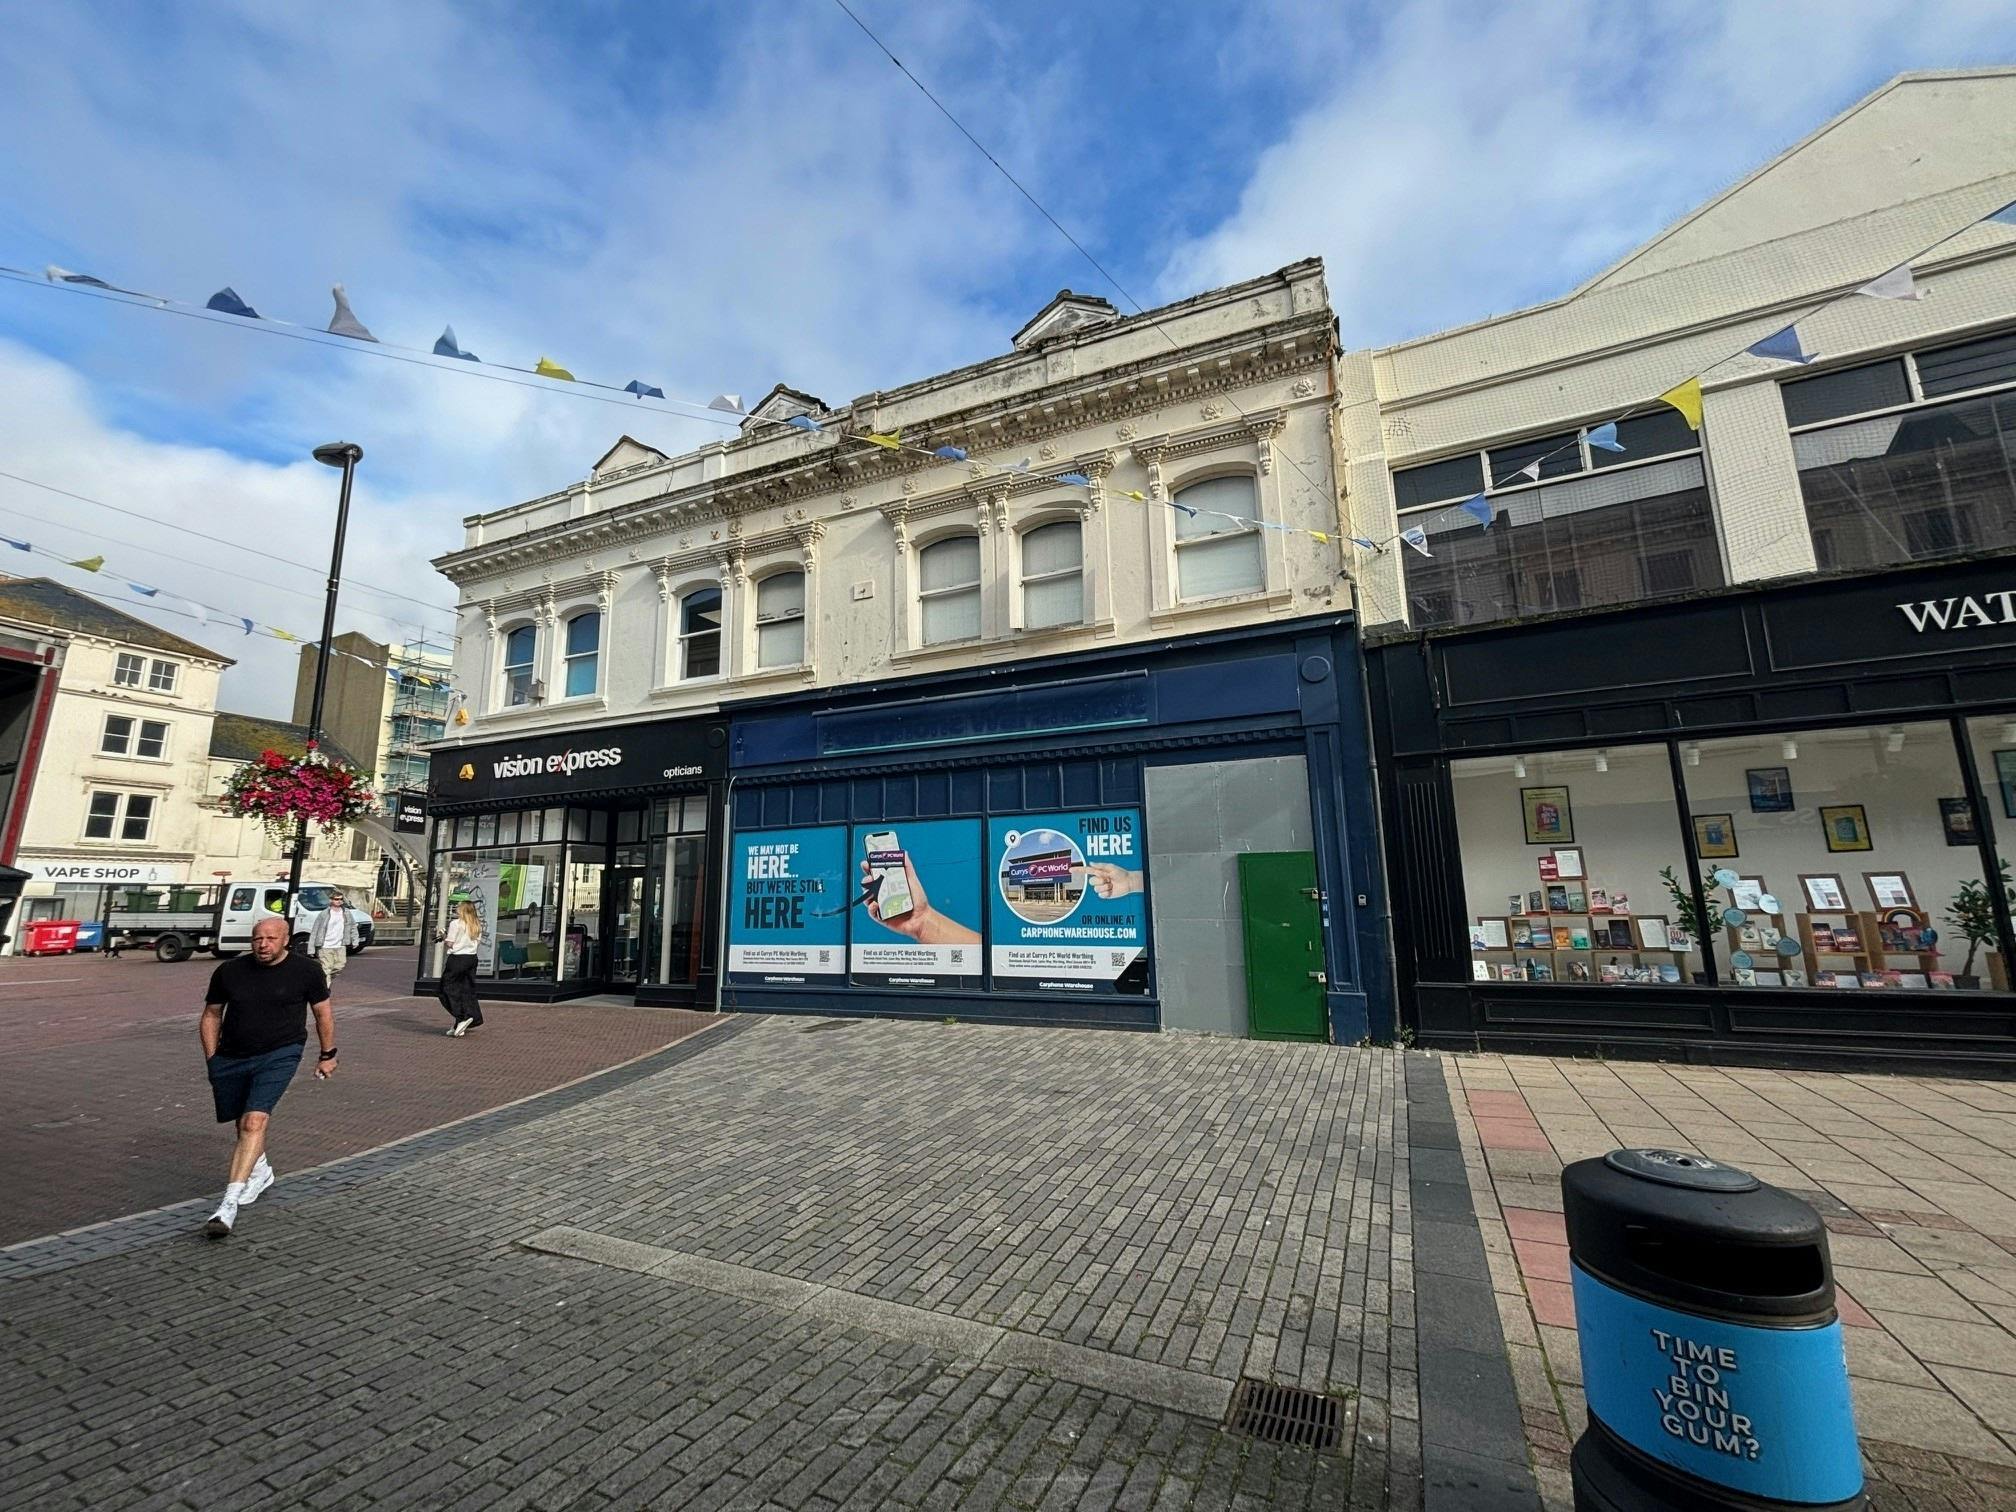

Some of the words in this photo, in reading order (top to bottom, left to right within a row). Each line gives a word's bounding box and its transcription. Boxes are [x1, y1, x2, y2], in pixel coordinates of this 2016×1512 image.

[494, 754, 542, 778] vision
[546, 748, 621, 776] express
[663, 765, 702, 779] opticians
[404, 805, 422, 815] vision
[1079, 817, 1109, 834] FIND
[1113, 816, 1132, 832] US
[748, 846, 759, 856] WE
[760, 845, 774, 855] MAY
[775, 844, 788, 854] NOT
[789, 844, 799, 854] BE
[1086, 834, 1133, 856] HERE
[44, 867, 90, 878] VAPE
[94, 867, 140, 879] SHOP
[747, 855, 799, 879] HERE...
[1010, 869, 1029, 877] Currys
[1047, 863, 1069, 872] World
[747, 881, 766, 894] BUT
[767, 880, 797, 894] WE'RE
[744, 896, 805, 929] HERE
[1082, 915, 1093, 925] OR
[1095, 915, 1123, 925] ONLINE
[1124, 915, 1135, 925] AT
[1021, 927, 1137, 939] CARPHONEWAREHOUSE.COM
[1650, 1328, 1737, 1370] TIME
[1674, 1356, 1720, 1386] TO
[1670, 1376, 1730, 1411] BIN
[1655, 1388, 1752, 1437] YOUR
[1662, 1414, 1760, 1460] GUM?
